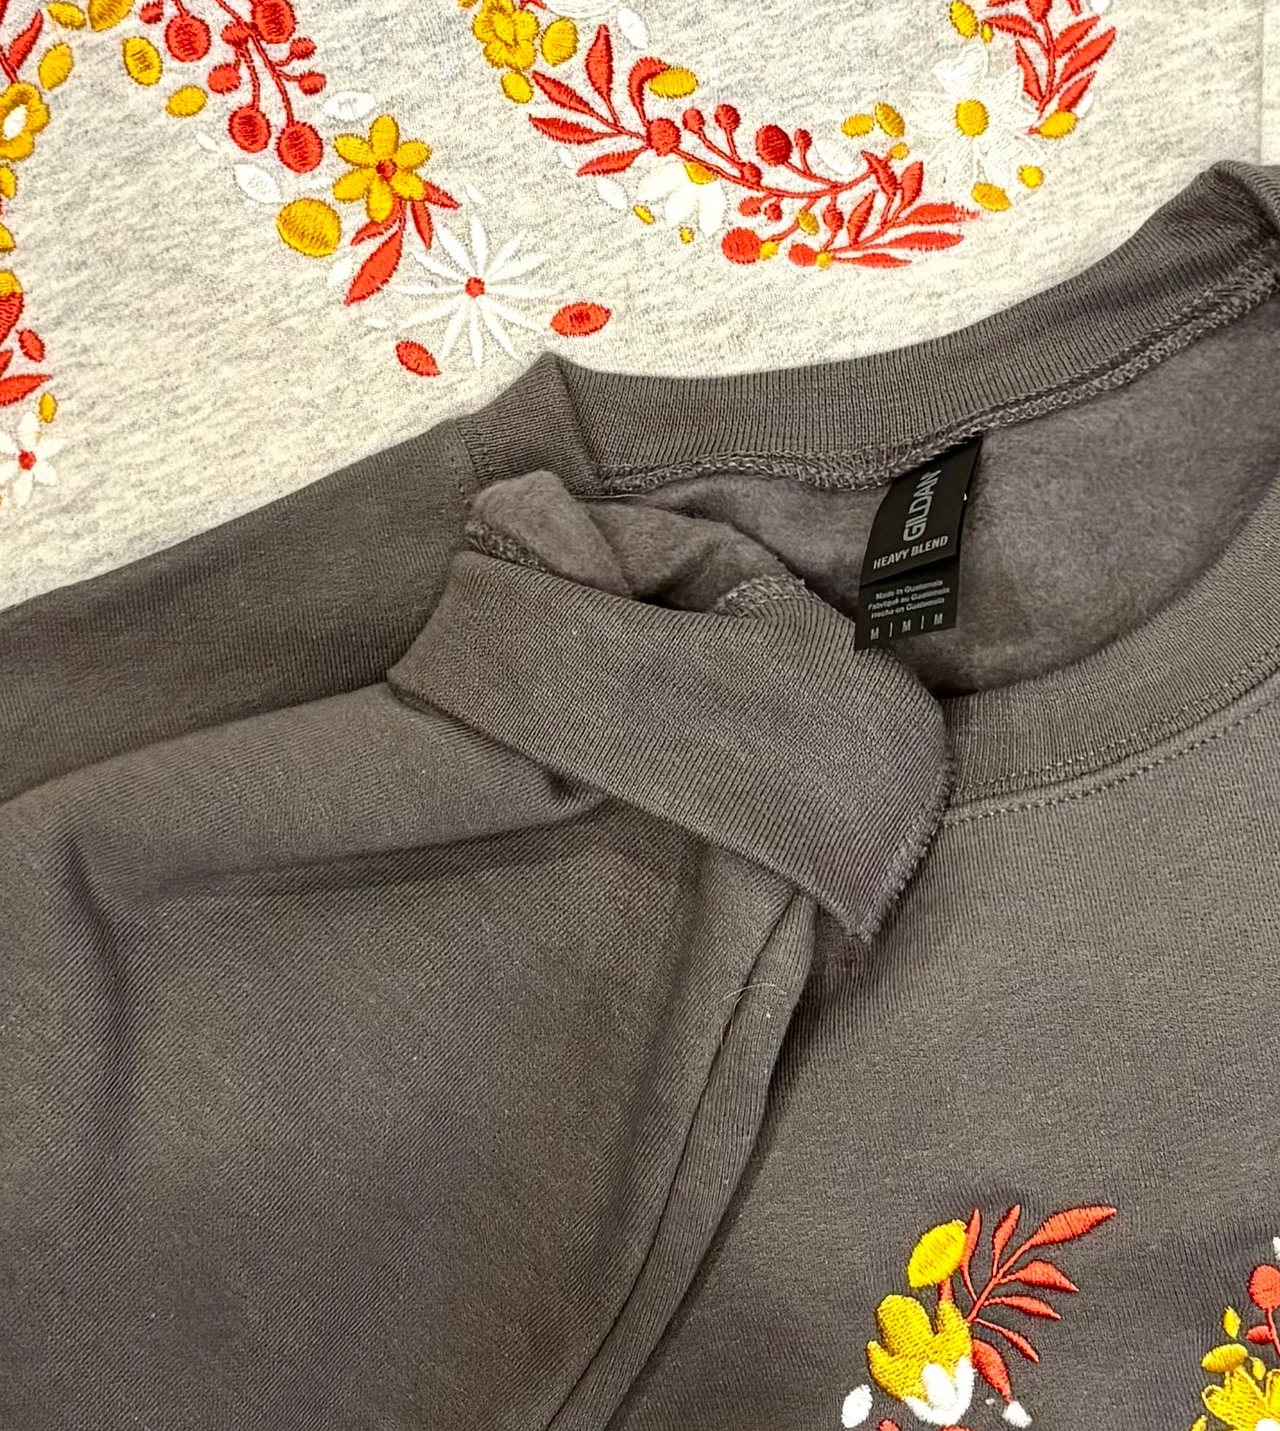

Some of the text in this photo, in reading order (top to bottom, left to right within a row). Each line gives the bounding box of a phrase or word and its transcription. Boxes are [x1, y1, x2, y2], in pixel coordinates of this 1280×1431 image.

[902, 469, 943, 542] GILDAN
[873, 535, 949, 570] HEAVY BLEND
[901, 619, 911, 633] M
[933, 612, 943, 626] M
